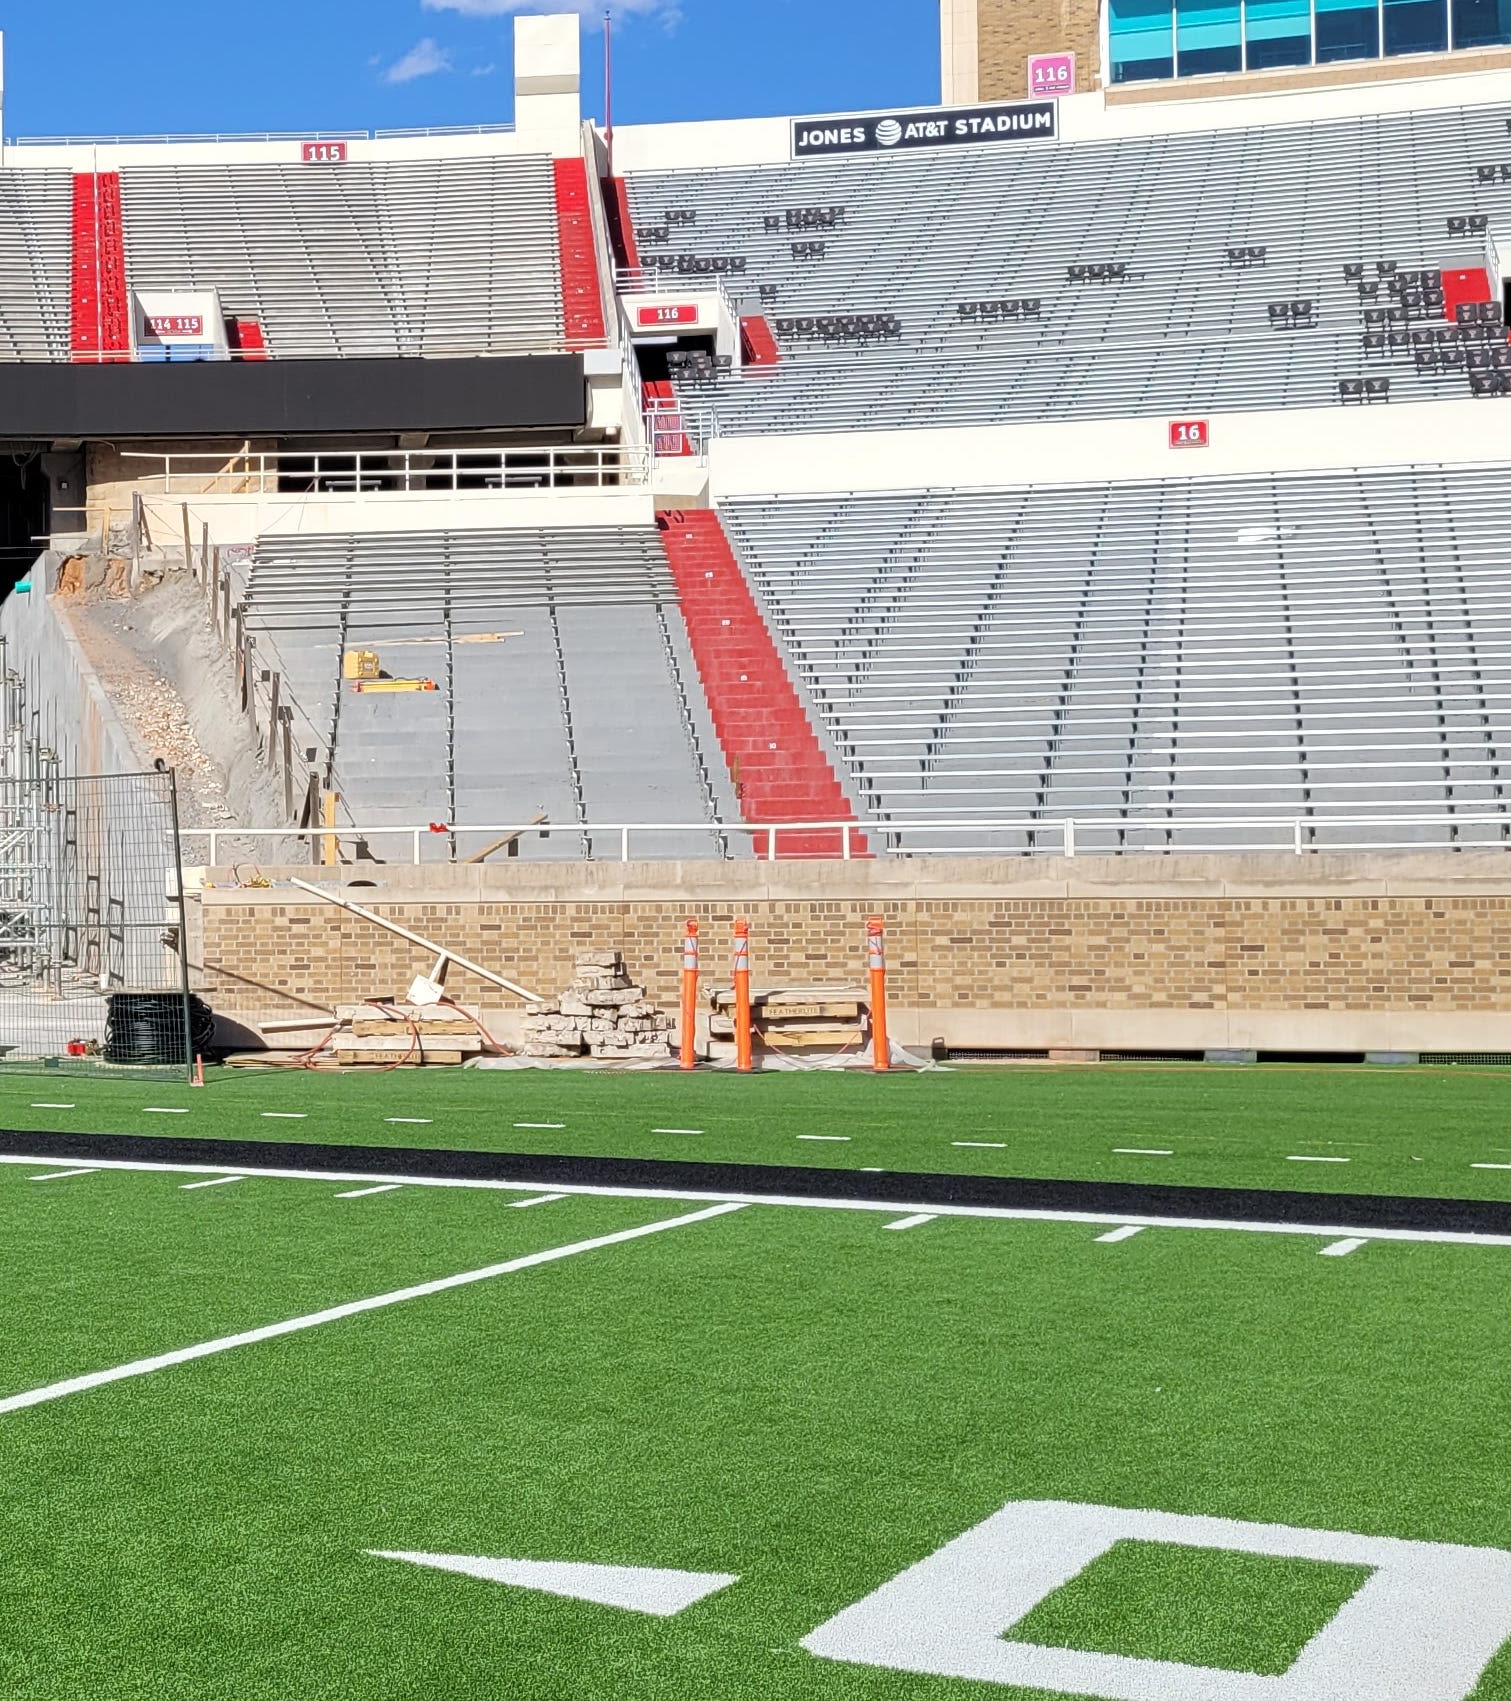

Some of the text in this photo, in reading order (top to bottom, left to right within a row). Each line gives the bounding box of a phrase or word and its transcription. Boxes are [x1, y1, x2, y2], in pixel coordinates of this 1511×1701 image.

[1035, 66, 1068, 83] 116
[798, 111, 1051, 147] JONES AT&T STADIUM
[308, 146, 340, 161] 115
[657, 307, 679, 320] 116
[150, 318, 199, 330] 114 115
[1178, 424, 1200, 441] 16
